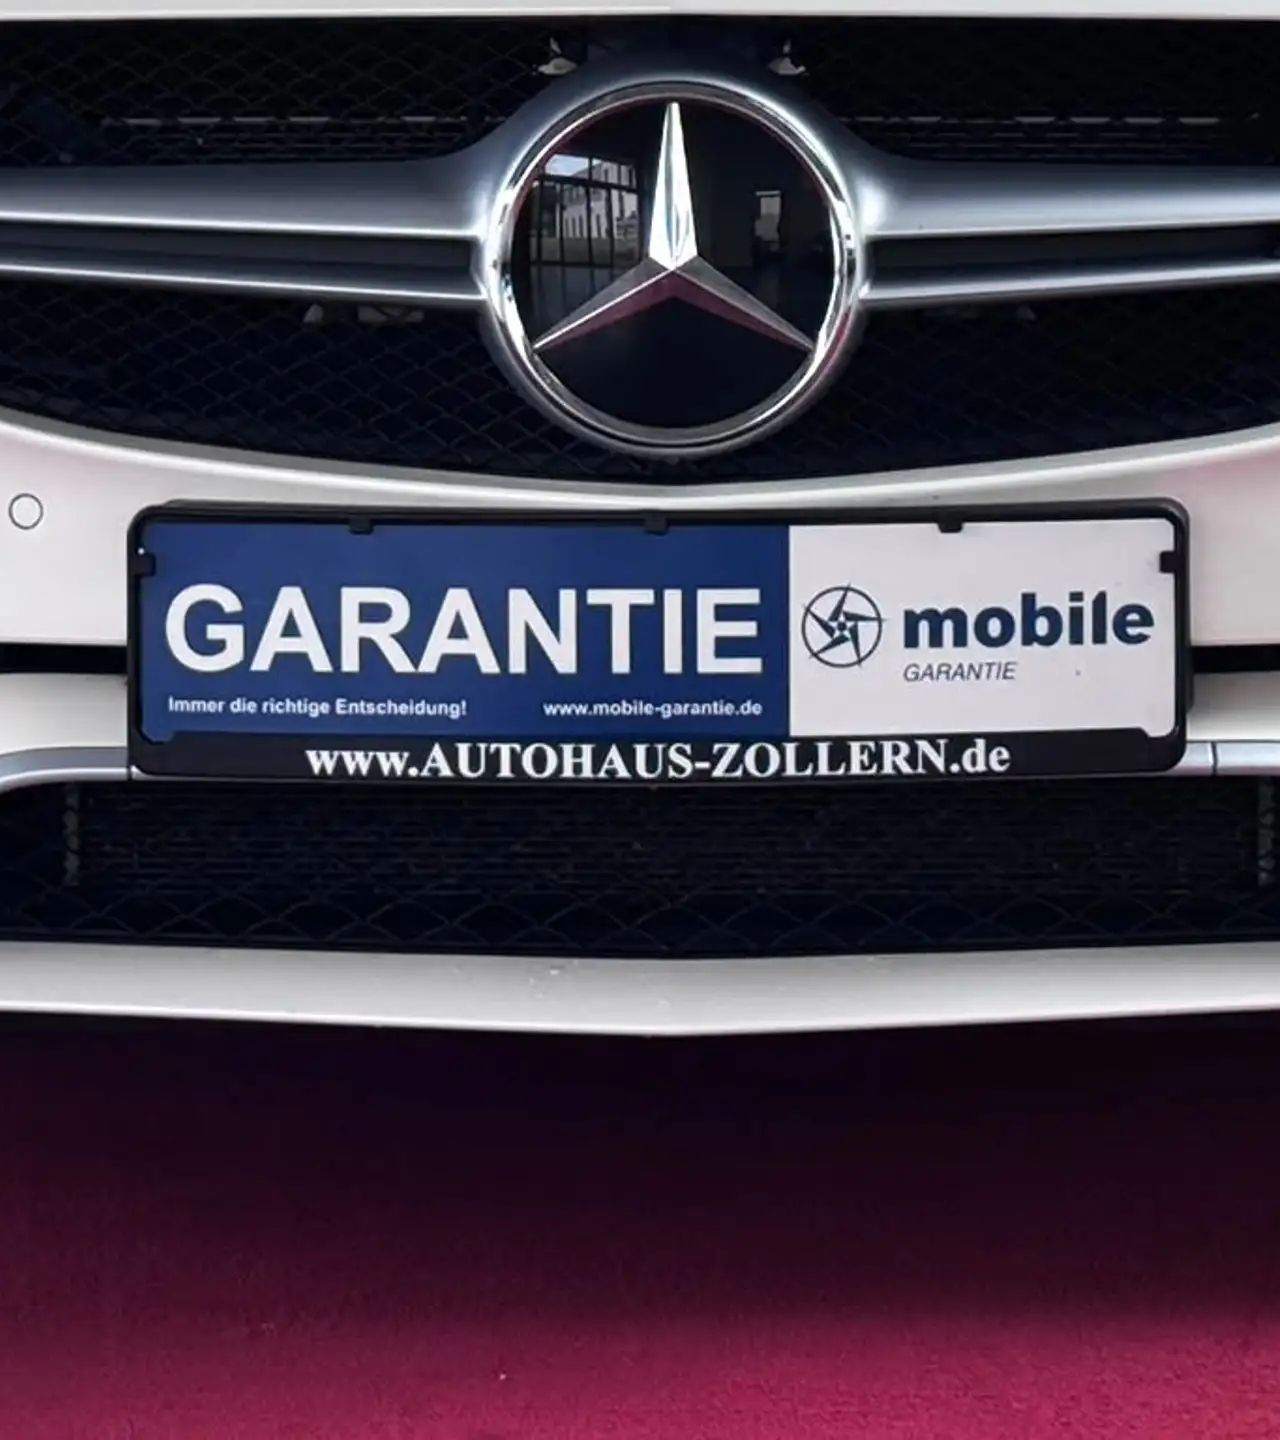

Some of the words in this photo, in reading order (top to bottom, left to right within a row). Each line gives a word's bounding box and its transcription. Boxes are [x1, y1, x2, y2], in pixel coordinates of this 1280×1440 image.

[165, 583, 762, 674] GARANTIE
[903, 590, 1155, 648] mobile
[903, 661, 1017, 682] GARANTIE
[168, 695, 224, 714] Immer
[229, 696, 256, 714] die
[261, 697, 330, 719] richtige
[334, 698, 467, 720] Entscheidung!
[542, 699, 763, 719] www.mobile-garantie.de
[305, 738, 1011, 780] www.AUTOHAUS-ZOLLERN.de
